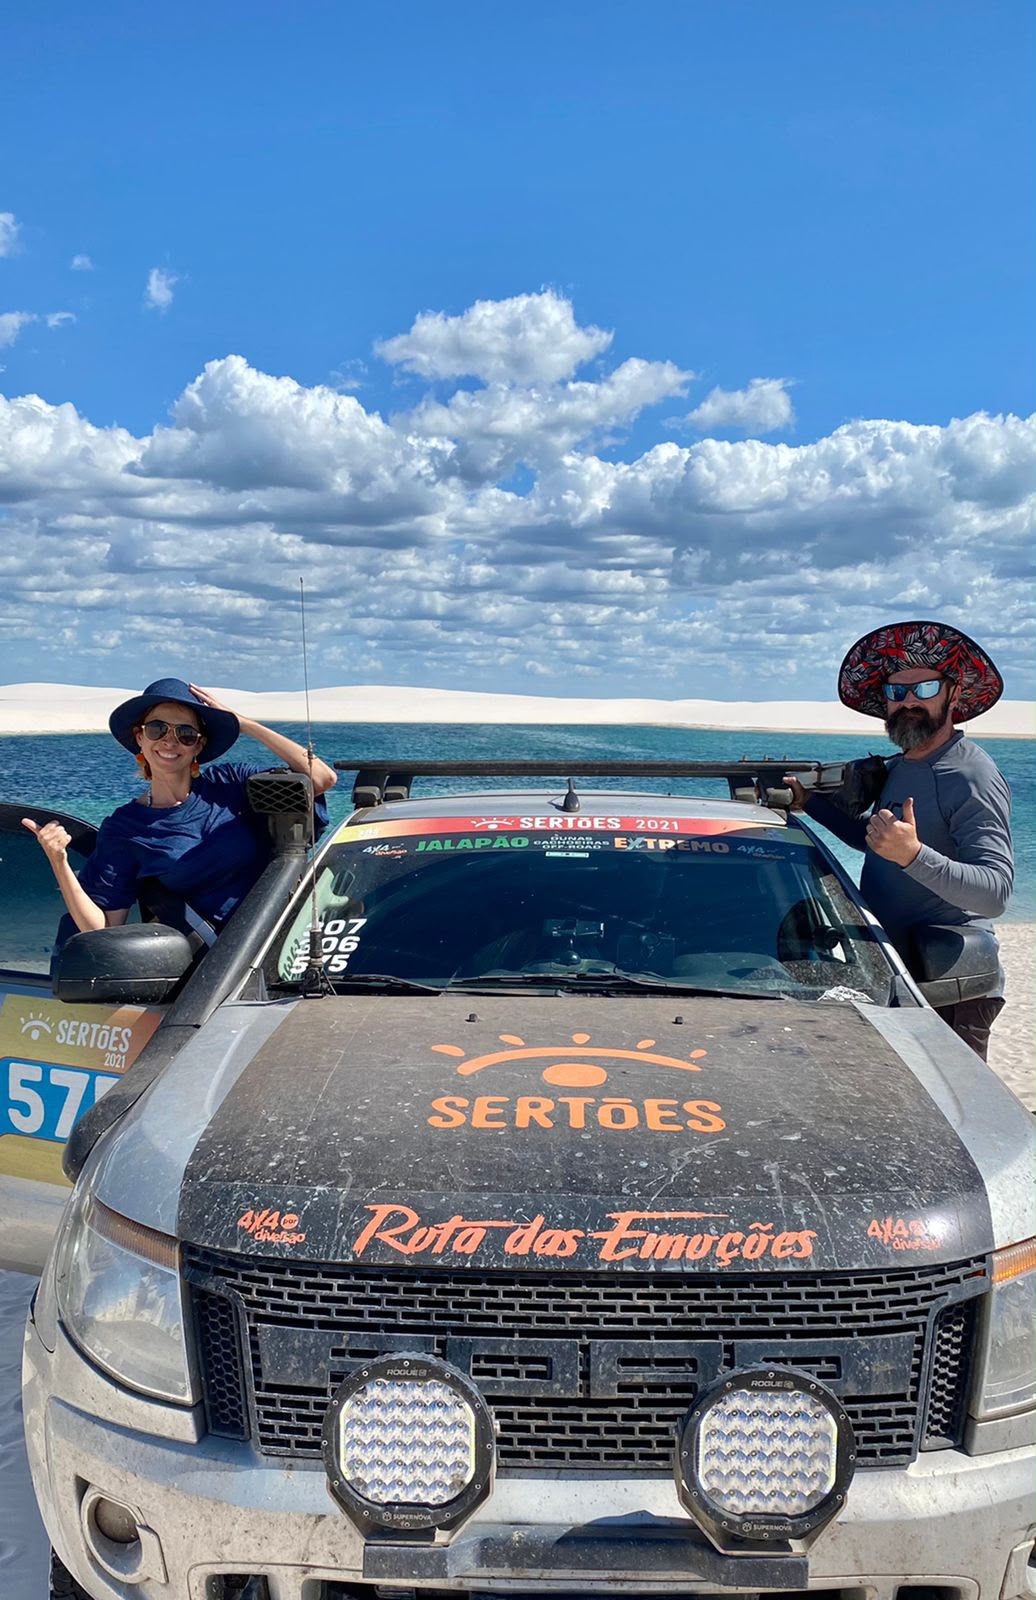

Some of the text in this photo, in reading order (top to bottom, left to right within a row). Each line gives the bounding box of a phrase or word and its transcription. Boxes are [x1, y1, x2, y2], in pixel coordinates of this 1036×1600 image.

[635, 819, 679, 831] 2021
[415, 835, 530, 852] JALAPÃO
[614, 837, 730, 854] EXTREMO
[103, 1052, 126, 1069] 2021
[8, 1062, 121, 1139] 57
[353, 1203, 817, 1267] Rota das Emoções
[386, 1368, 418, 1376] ROGUE
[750, 1380, 783, 1388] ROGUE
[393, 1513, 432, 1521] SUPERNOVA
[752, 1523, 793, 1532] SUPERNOVA
